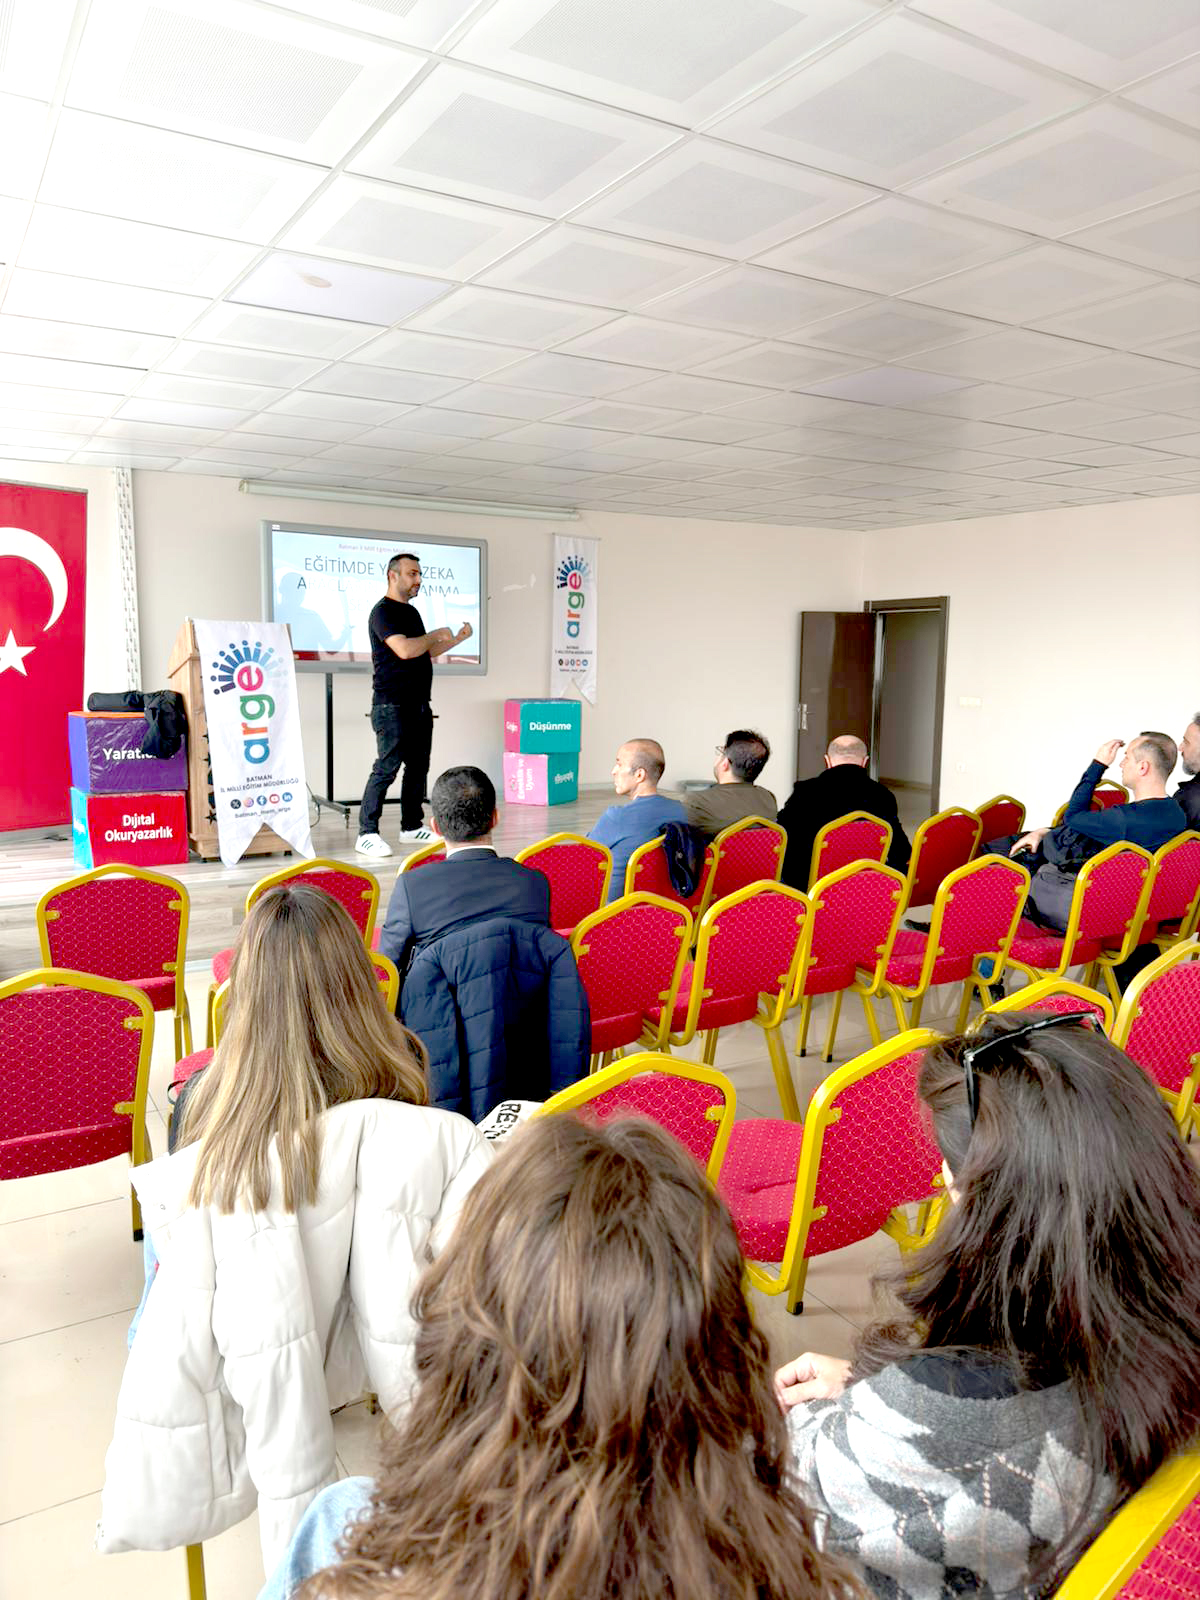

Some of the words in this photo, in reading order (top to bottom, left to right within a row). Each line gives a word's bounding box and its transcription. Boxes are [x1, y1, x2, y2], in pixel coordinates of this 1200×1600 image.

[304, 555, 375, 576] EĞİTİMDE
[422, 566, 454, 580] ZEKA
[566, 571, 585, 638] arge
[237, 664, 275, 764] arge
[529, 721, 572, 733] Düşünme
[242, 783, 262, 791] EĞİTİM
[263, 778, 299, 787] MÜDÜRLÜĞÜ
[246, 774, 273, 783] BATMAN
[104, 826, 173, 843] Okuryazarlık
